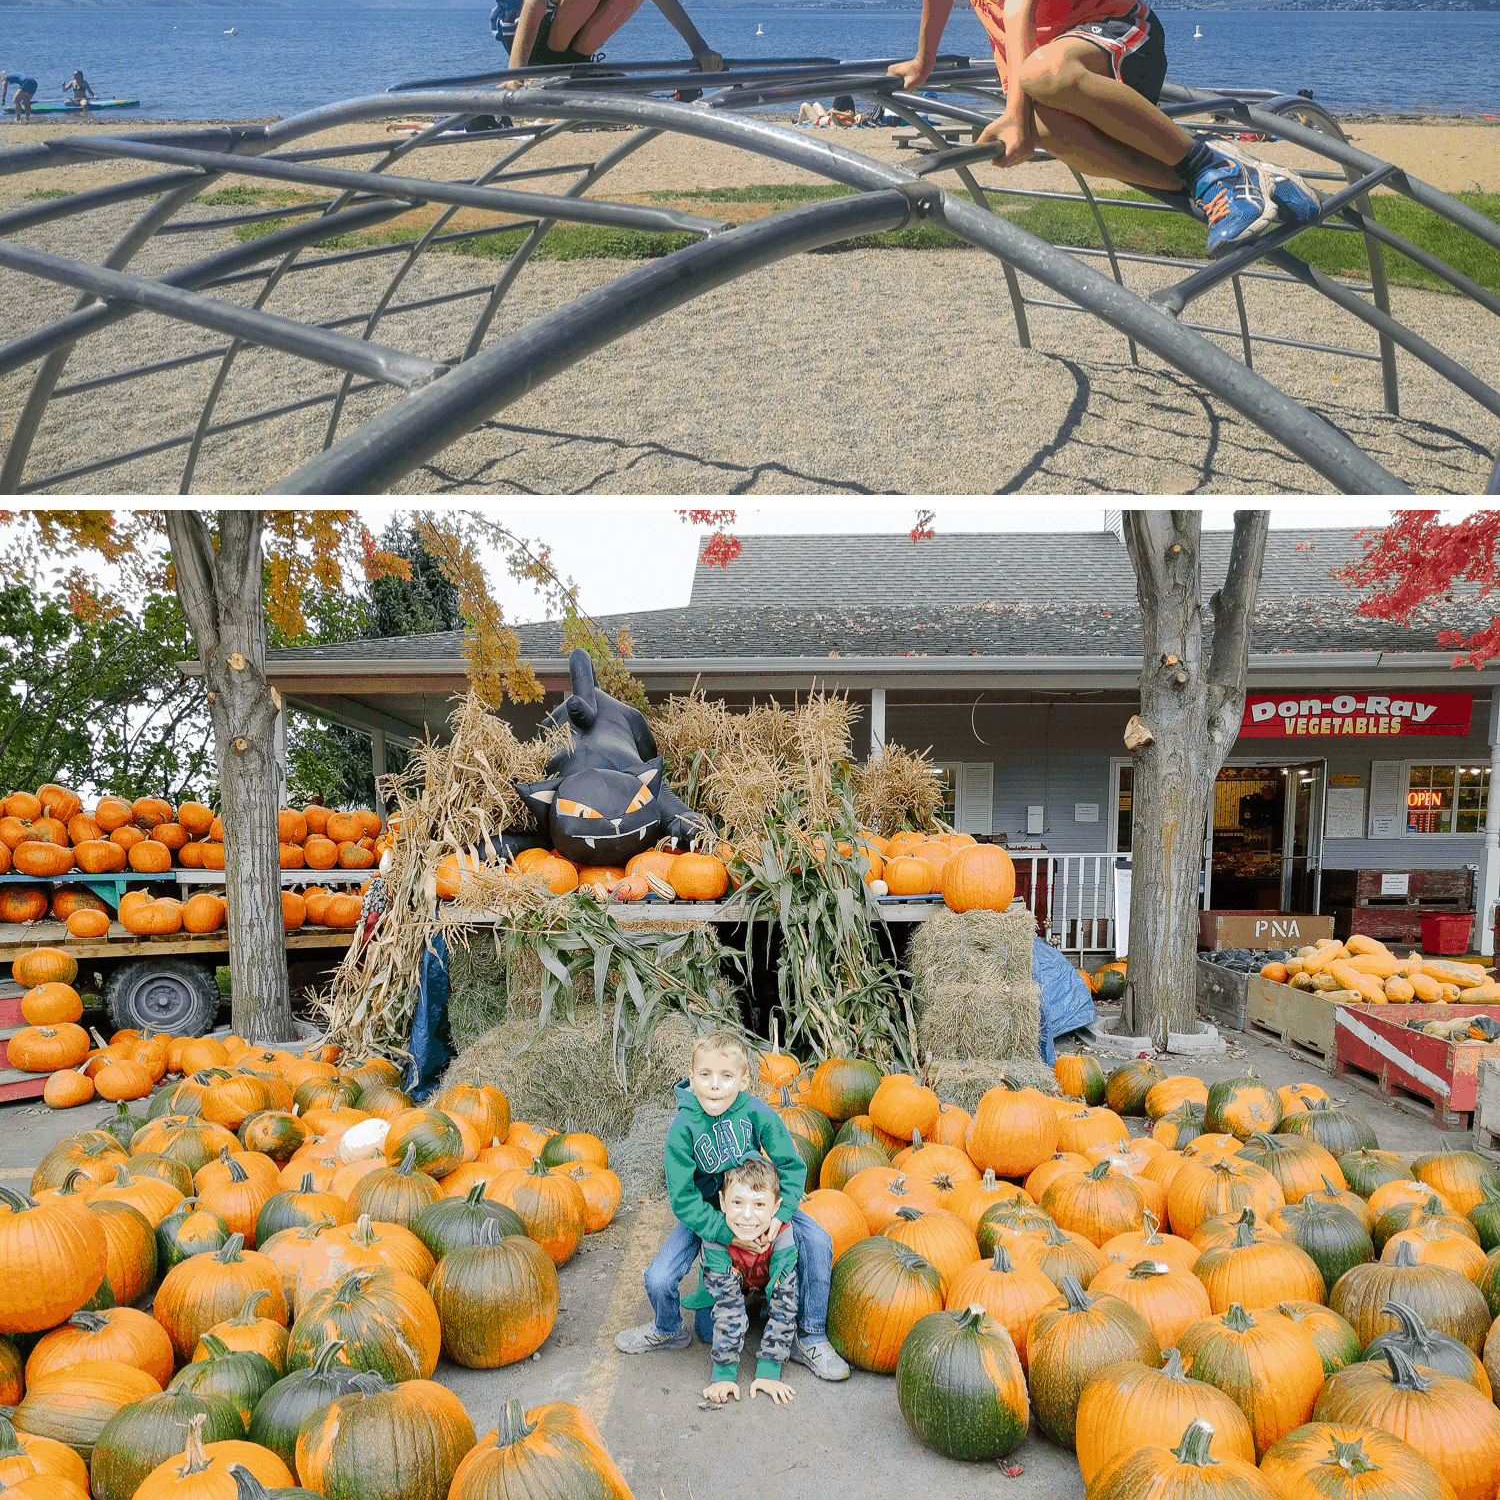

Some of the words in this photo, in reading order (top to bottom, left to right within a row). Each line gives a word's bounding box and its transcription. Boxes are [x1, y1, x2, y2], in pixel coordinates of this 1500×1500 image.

[1251, 695, 1437, 723] Don-O-Ray
[1284, 717, 1402, 735] VEGETABLES
[1407, 792, 1442, 807] OPEN
[1255, 919, 1301, 939] PNA
